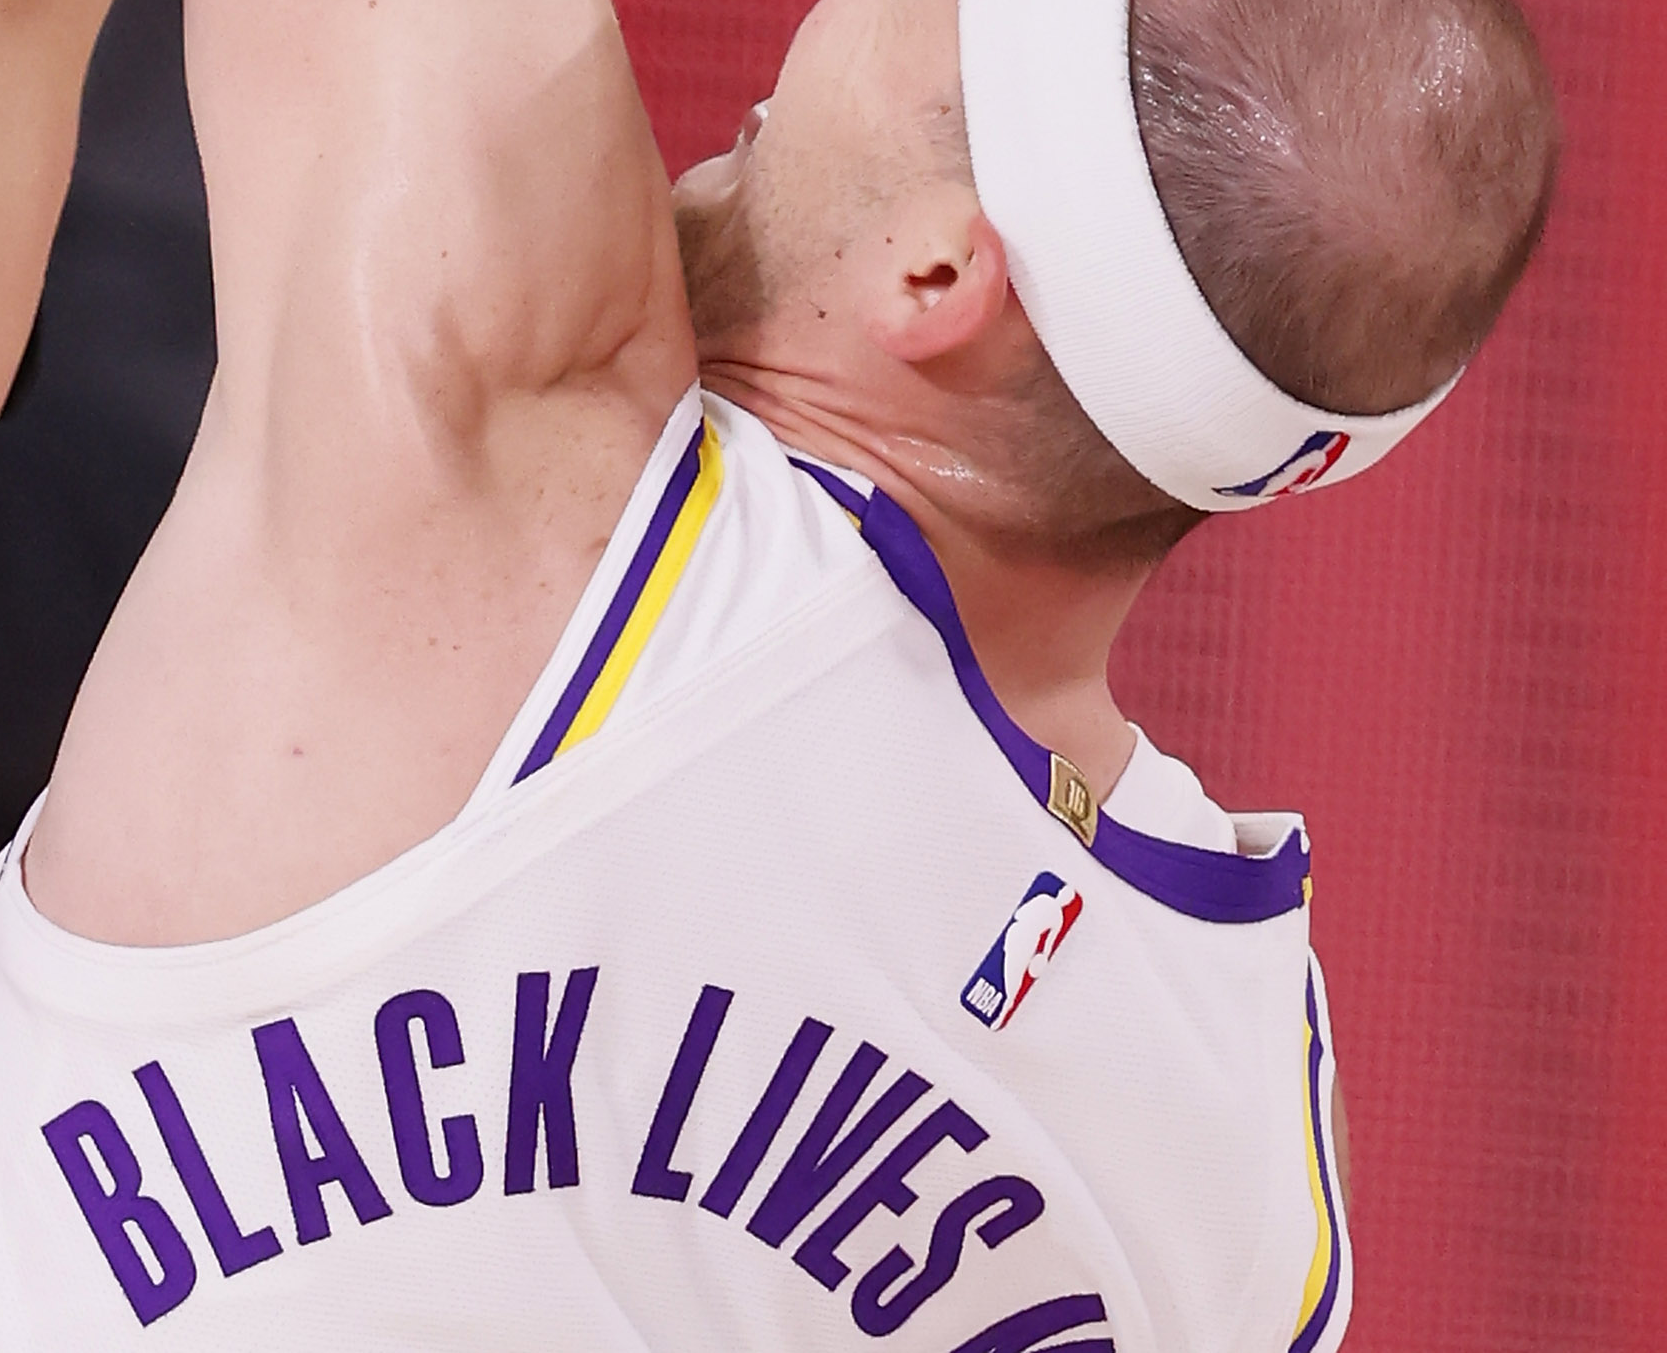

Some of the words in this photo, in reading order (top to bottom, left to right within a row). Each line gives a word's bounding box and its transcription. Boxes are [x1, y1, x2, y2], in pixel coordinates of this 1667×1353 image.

[966, 977, 1003, 1018] NBA
[41, 966, 600, 1327] BLACK
[631, 984, 1045, 1338] LIVES
